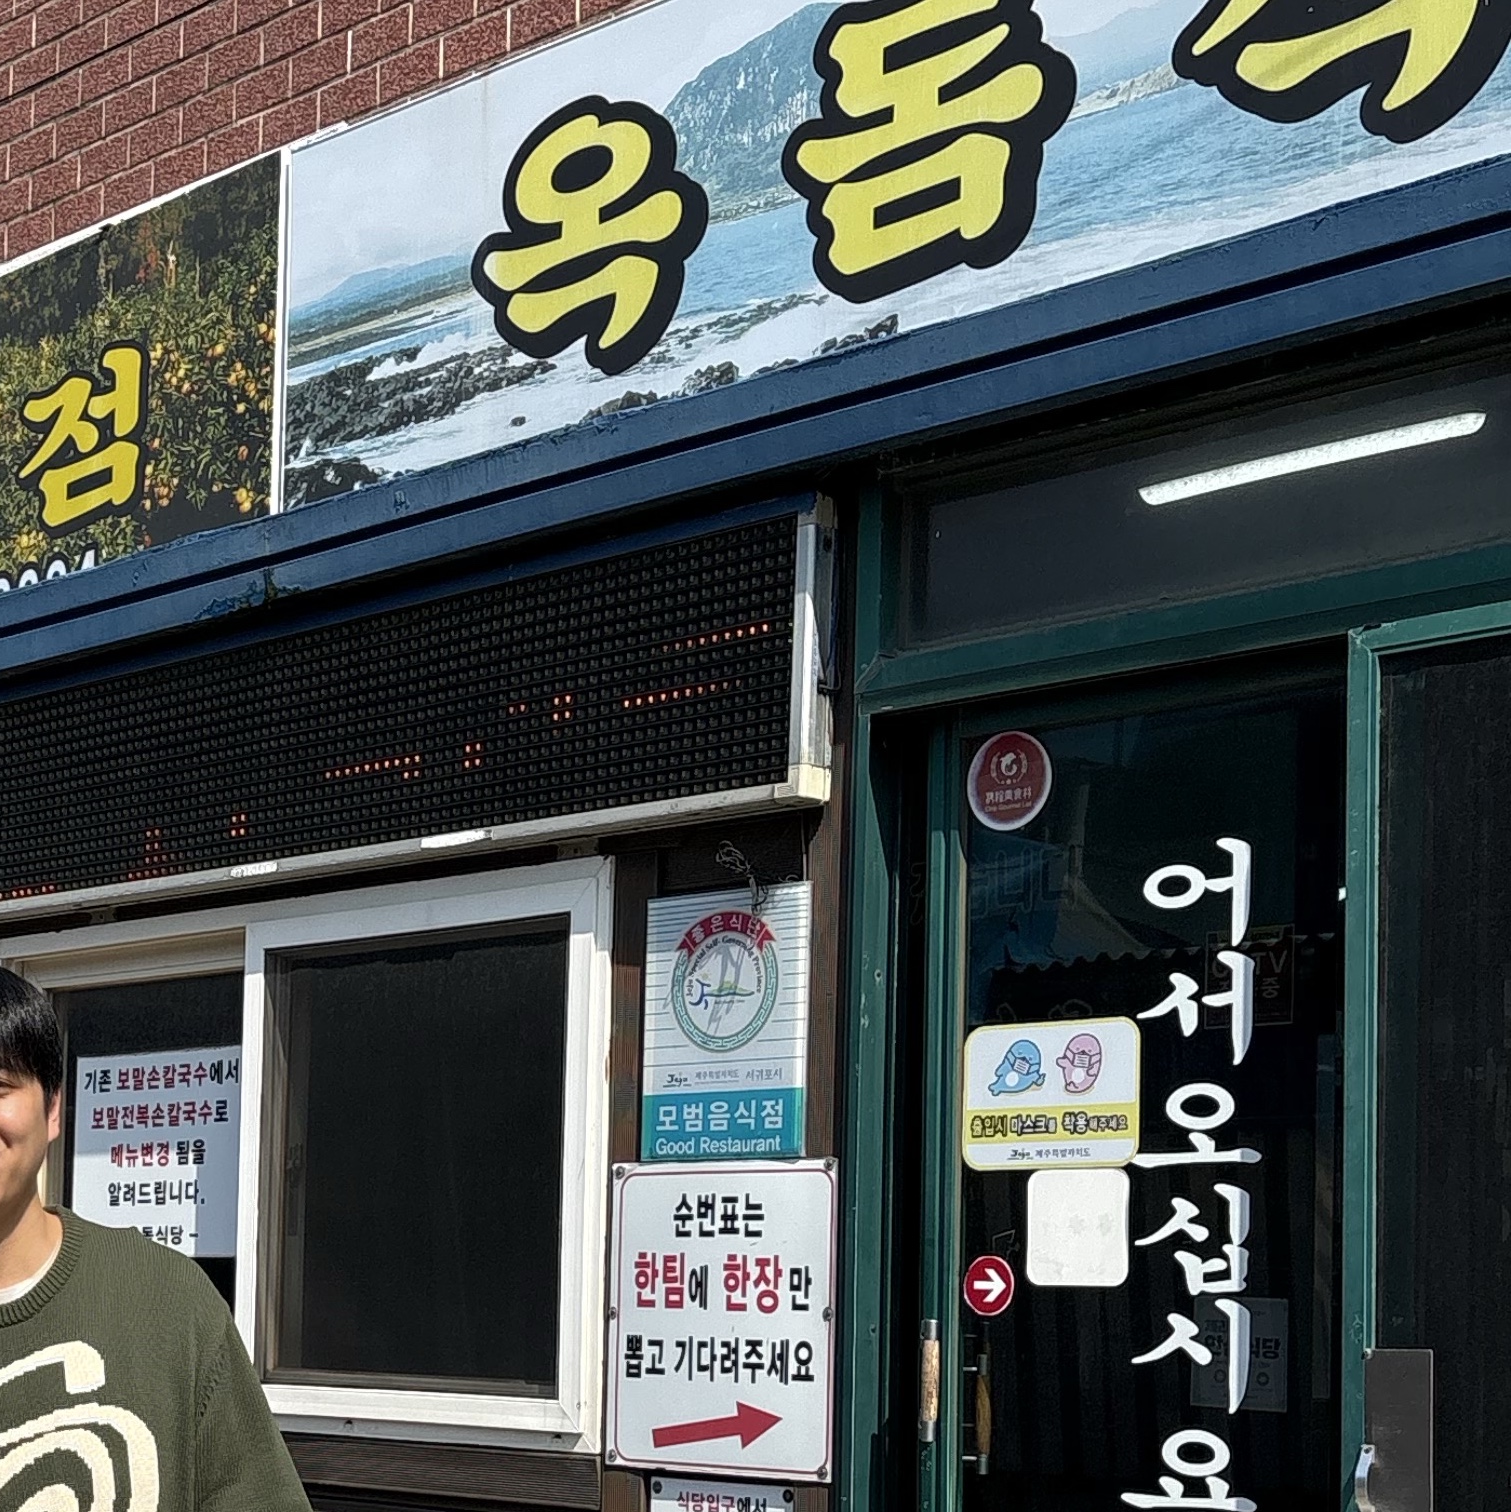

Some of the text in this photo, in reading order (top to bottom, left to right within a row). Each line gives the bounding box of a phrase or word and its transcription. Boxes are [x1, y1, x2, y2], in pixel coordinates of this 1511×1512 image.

[84, 1056, 240, 1094] 기존 보말손칼국수에서
[745, 1067, 783, 1081] 서귀포시
[91, 1099, 229, 1131] 보말전복손칼국수로
[655, 1098, 784, 1133] 모범음식점
[971, 1115, 1008, 1138] 출입시
[1009, 1113, 1058, 1135] 마스크를
[110, 1138, 207, 1168] 메뉴변경 됨을
[655, 1134, 782, 1156] Good Restaurant
[107, 1179, 206, 1207] 알려드립니다.
[673, 1193, 766, 1239] 순번표는
[633, 1250, 812, 1315] 한팀에 한장만
[624, 1334, 815, 1386] 뽑고 기다려주세요
